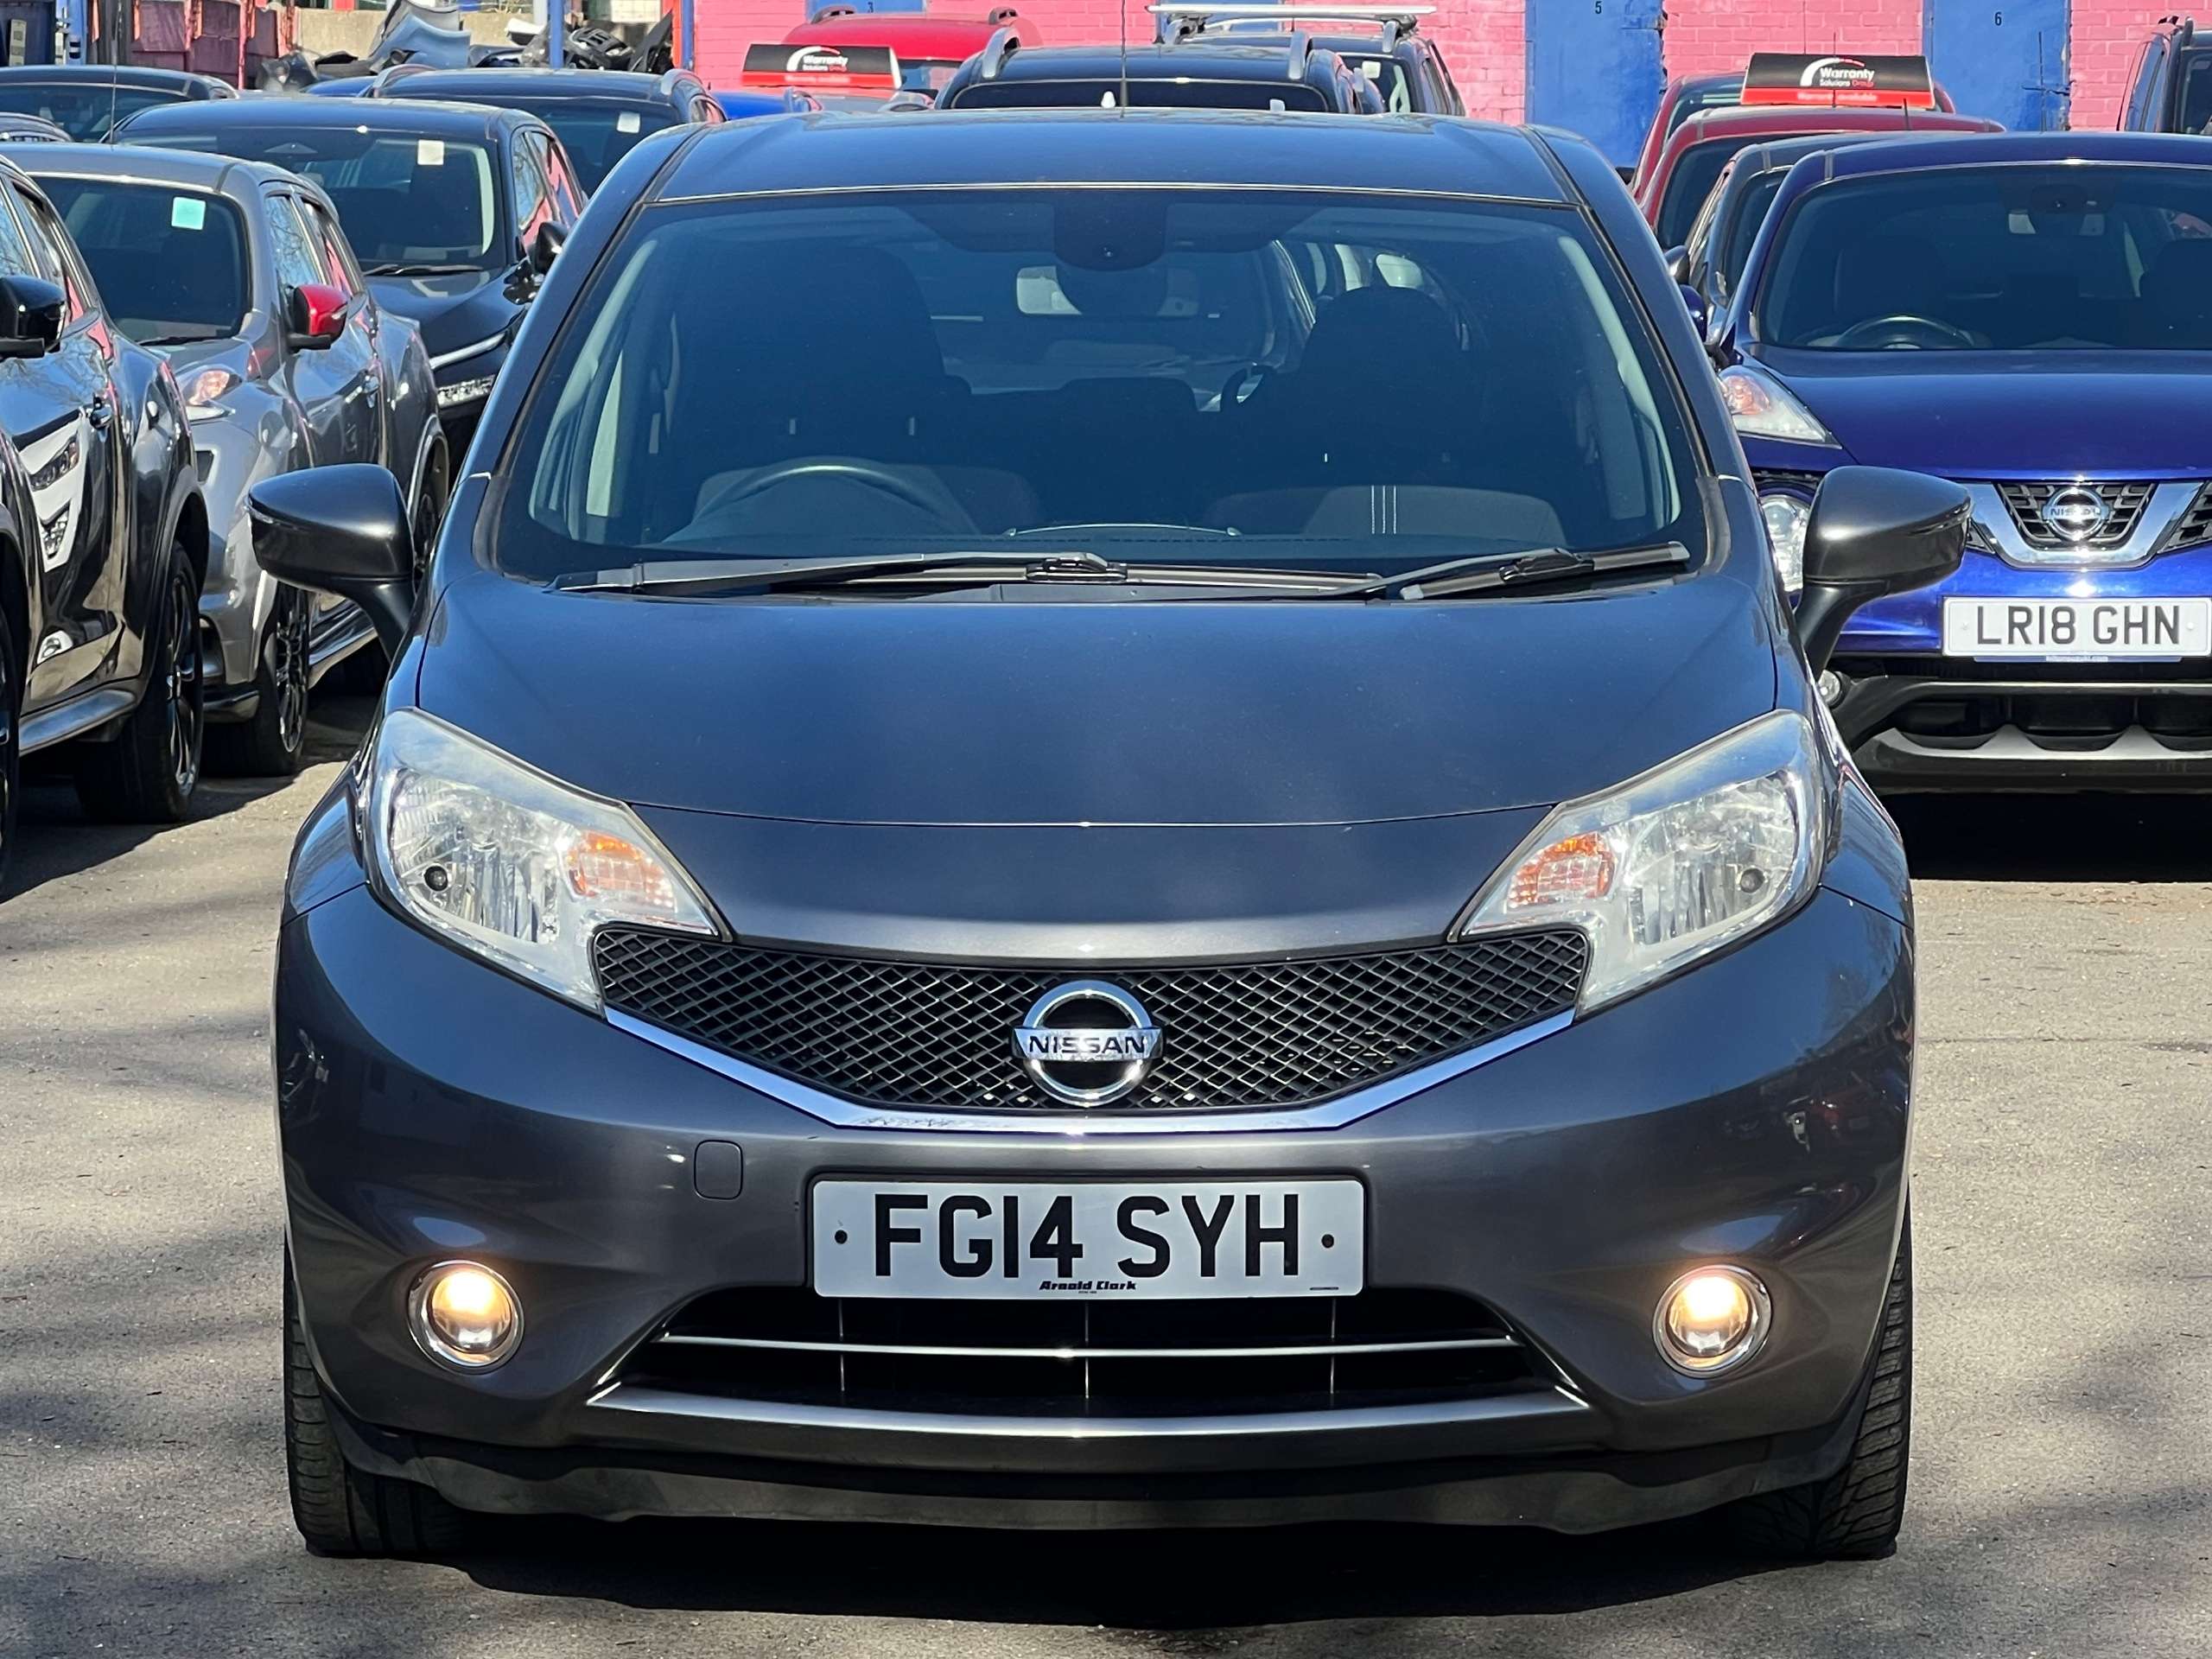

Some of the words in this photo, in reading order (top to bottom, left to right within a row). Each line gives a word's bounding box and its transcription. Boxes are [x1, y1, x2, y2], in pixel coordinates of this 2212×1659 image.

[1595, 1, 1602, 15] 5
[1994, 11, 2002, 26] 6
[1820, 67, 1875, 81] Warranty
[1977, 606, 2076, 645] LR18
[2093, 606, 2180, 645] GHN
[1029, 1036, 1145, 1053] NISSAN
[874, 1193, 1084, 1278] FG14
[1116, 1194, 1299, 1279] SYH
[1039, 1281, 1092, 1290] Arnold
[1096, 1281, 1136, 1290] Clark
